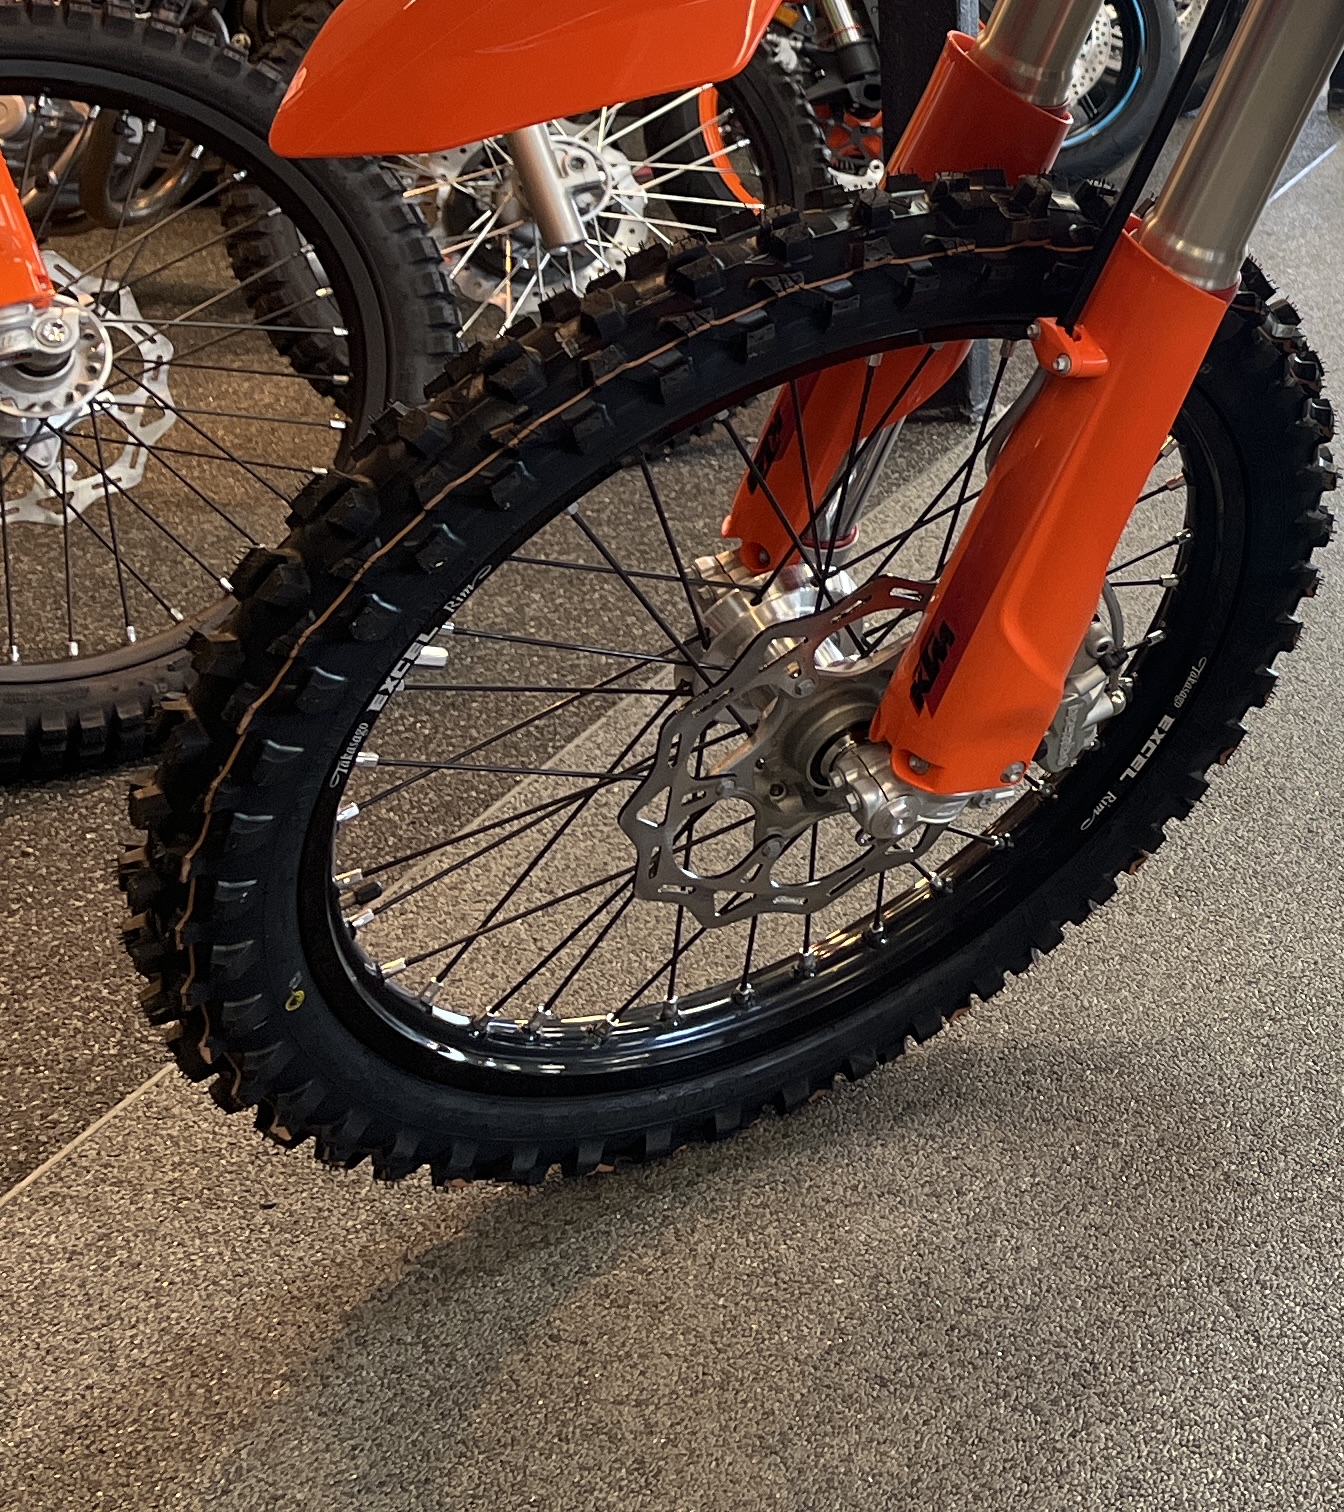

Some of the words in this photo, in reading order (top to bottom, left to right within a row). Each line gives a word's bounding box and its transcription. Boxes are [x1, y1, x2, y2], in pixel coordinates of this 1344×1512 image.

[329, 722, 369, 788] Takasago
[366, 626, 439, 711] EXCEL
[443, 564, 492, 613] Rim
[909, 617, 956, 717] KTM
[1173, 656, 1208, 709] Takasago
[1119, 714, 1177, 781] EXCEL
[1080, 790, 1118, 831] Rim
